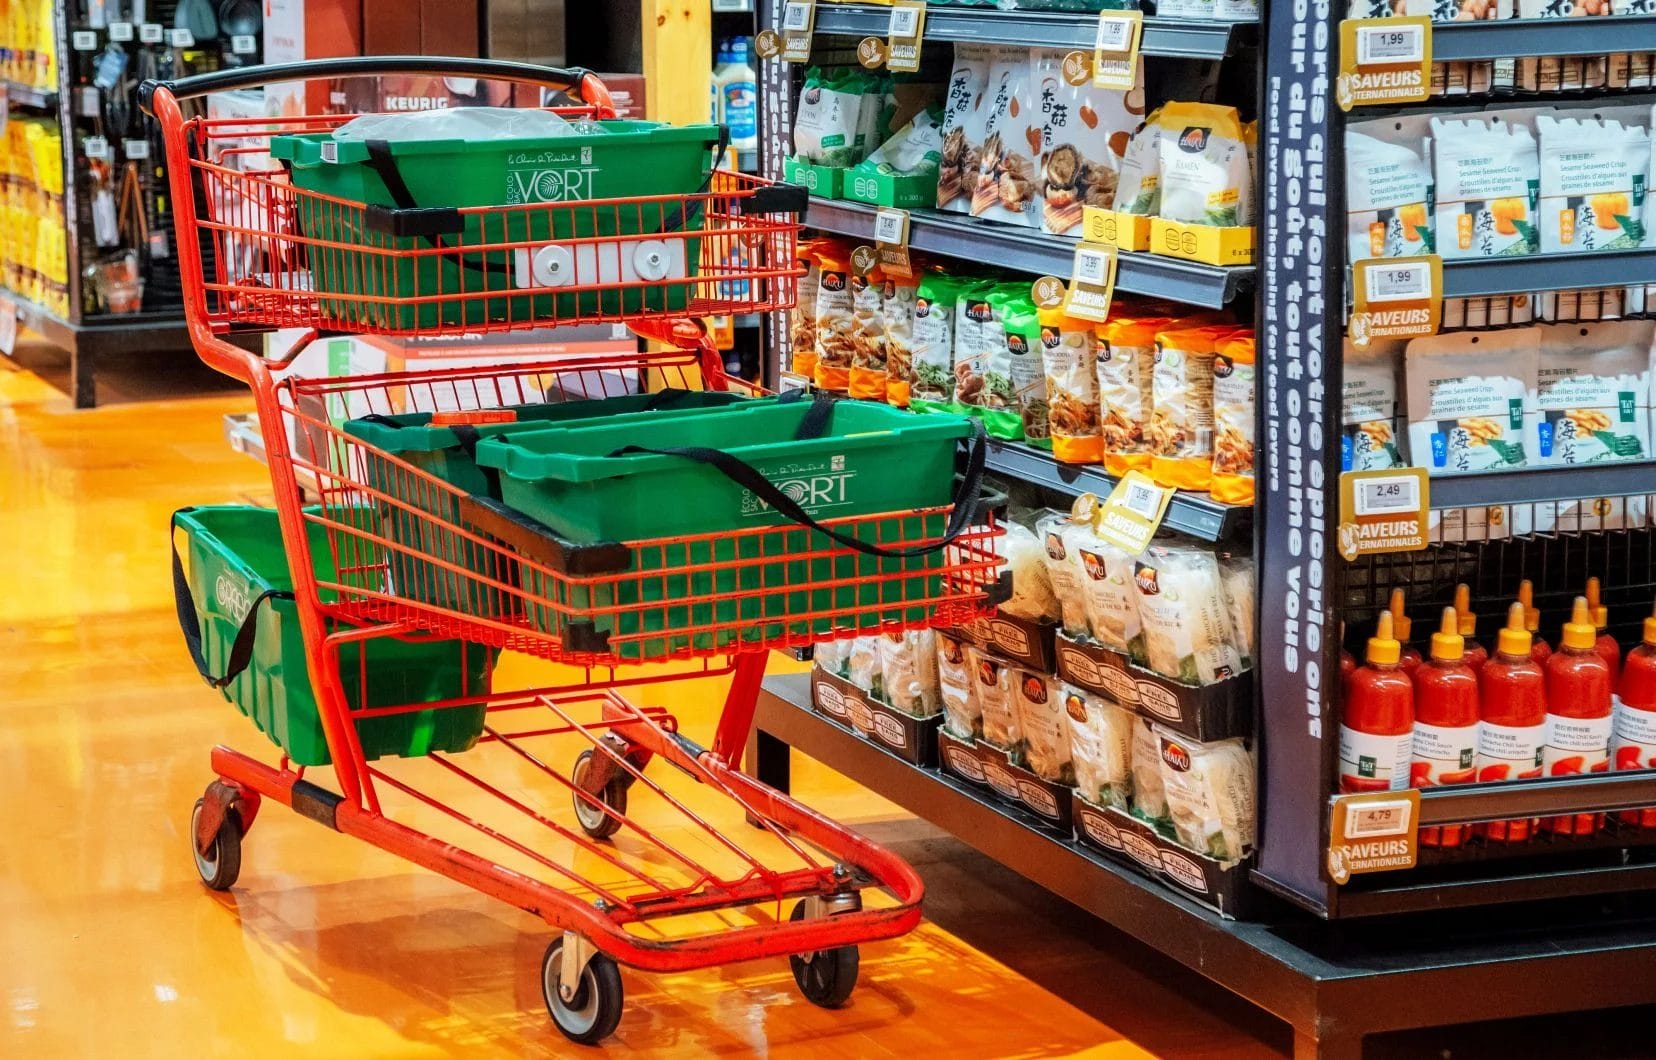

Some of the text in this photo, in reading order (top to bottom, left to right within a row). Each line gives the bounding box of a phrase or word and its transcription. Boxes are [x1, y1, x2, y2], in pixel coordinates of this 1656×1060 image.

[1380, 33, 1404, 46] 1,99
[1352, 70, 1422, 89] SAVEURS
[386, 97, 449, 110] KEURIG
[1288, 82, 1307, 140] du
[1306, 133, 1326, 206] qui
[1582, 162, 1609, 170] Seaweed
[1561, 174, 1591, 182] Croustilles
[1561, 183, 1583, 191] graines
[1283, 147, 1305, 270] goût,
[1307, 214, 1325, 315] font
[1266, 76, 1281, 491] Food lovers shopping for food lovers
[1388, 271, 1411, 283] 1,99
[1286, 280, 1303, 380] tout
[1370, 324, 1432, 337] ERNATIONALES
[1307, 323, 1324, 451] votre
[1454, 386, 1479, 394] Seaweed
[1430, 398, 1466, 406] Croustilles
[1467, 396, 1491, 406] d'algues
[1539, 396, 1564, 404] graines
[1431, 407, 1455, 416] graines
[1287, 388, 1303, 557] comme
[1377, 485, 1400, 496] 2,49
[1104, 510, 1150, 539] SAVEURS
[1360, 537, 1422, 549] ERNATIONALES
[1306, 460, 1325, 653] épicerie
[1284, 565, 1301, 674] vous
[1024, 685, 1046, 700] HAIKU
[1306, 660, 1322, 739] ont
[1554, 731, 1576, 740] Sriracha
[1163, 751, 1190, 769] HAIKU
[1368, 810, 1391, 821] 4,79
[1351, 856, 1412, 870] ERNATIONALES
